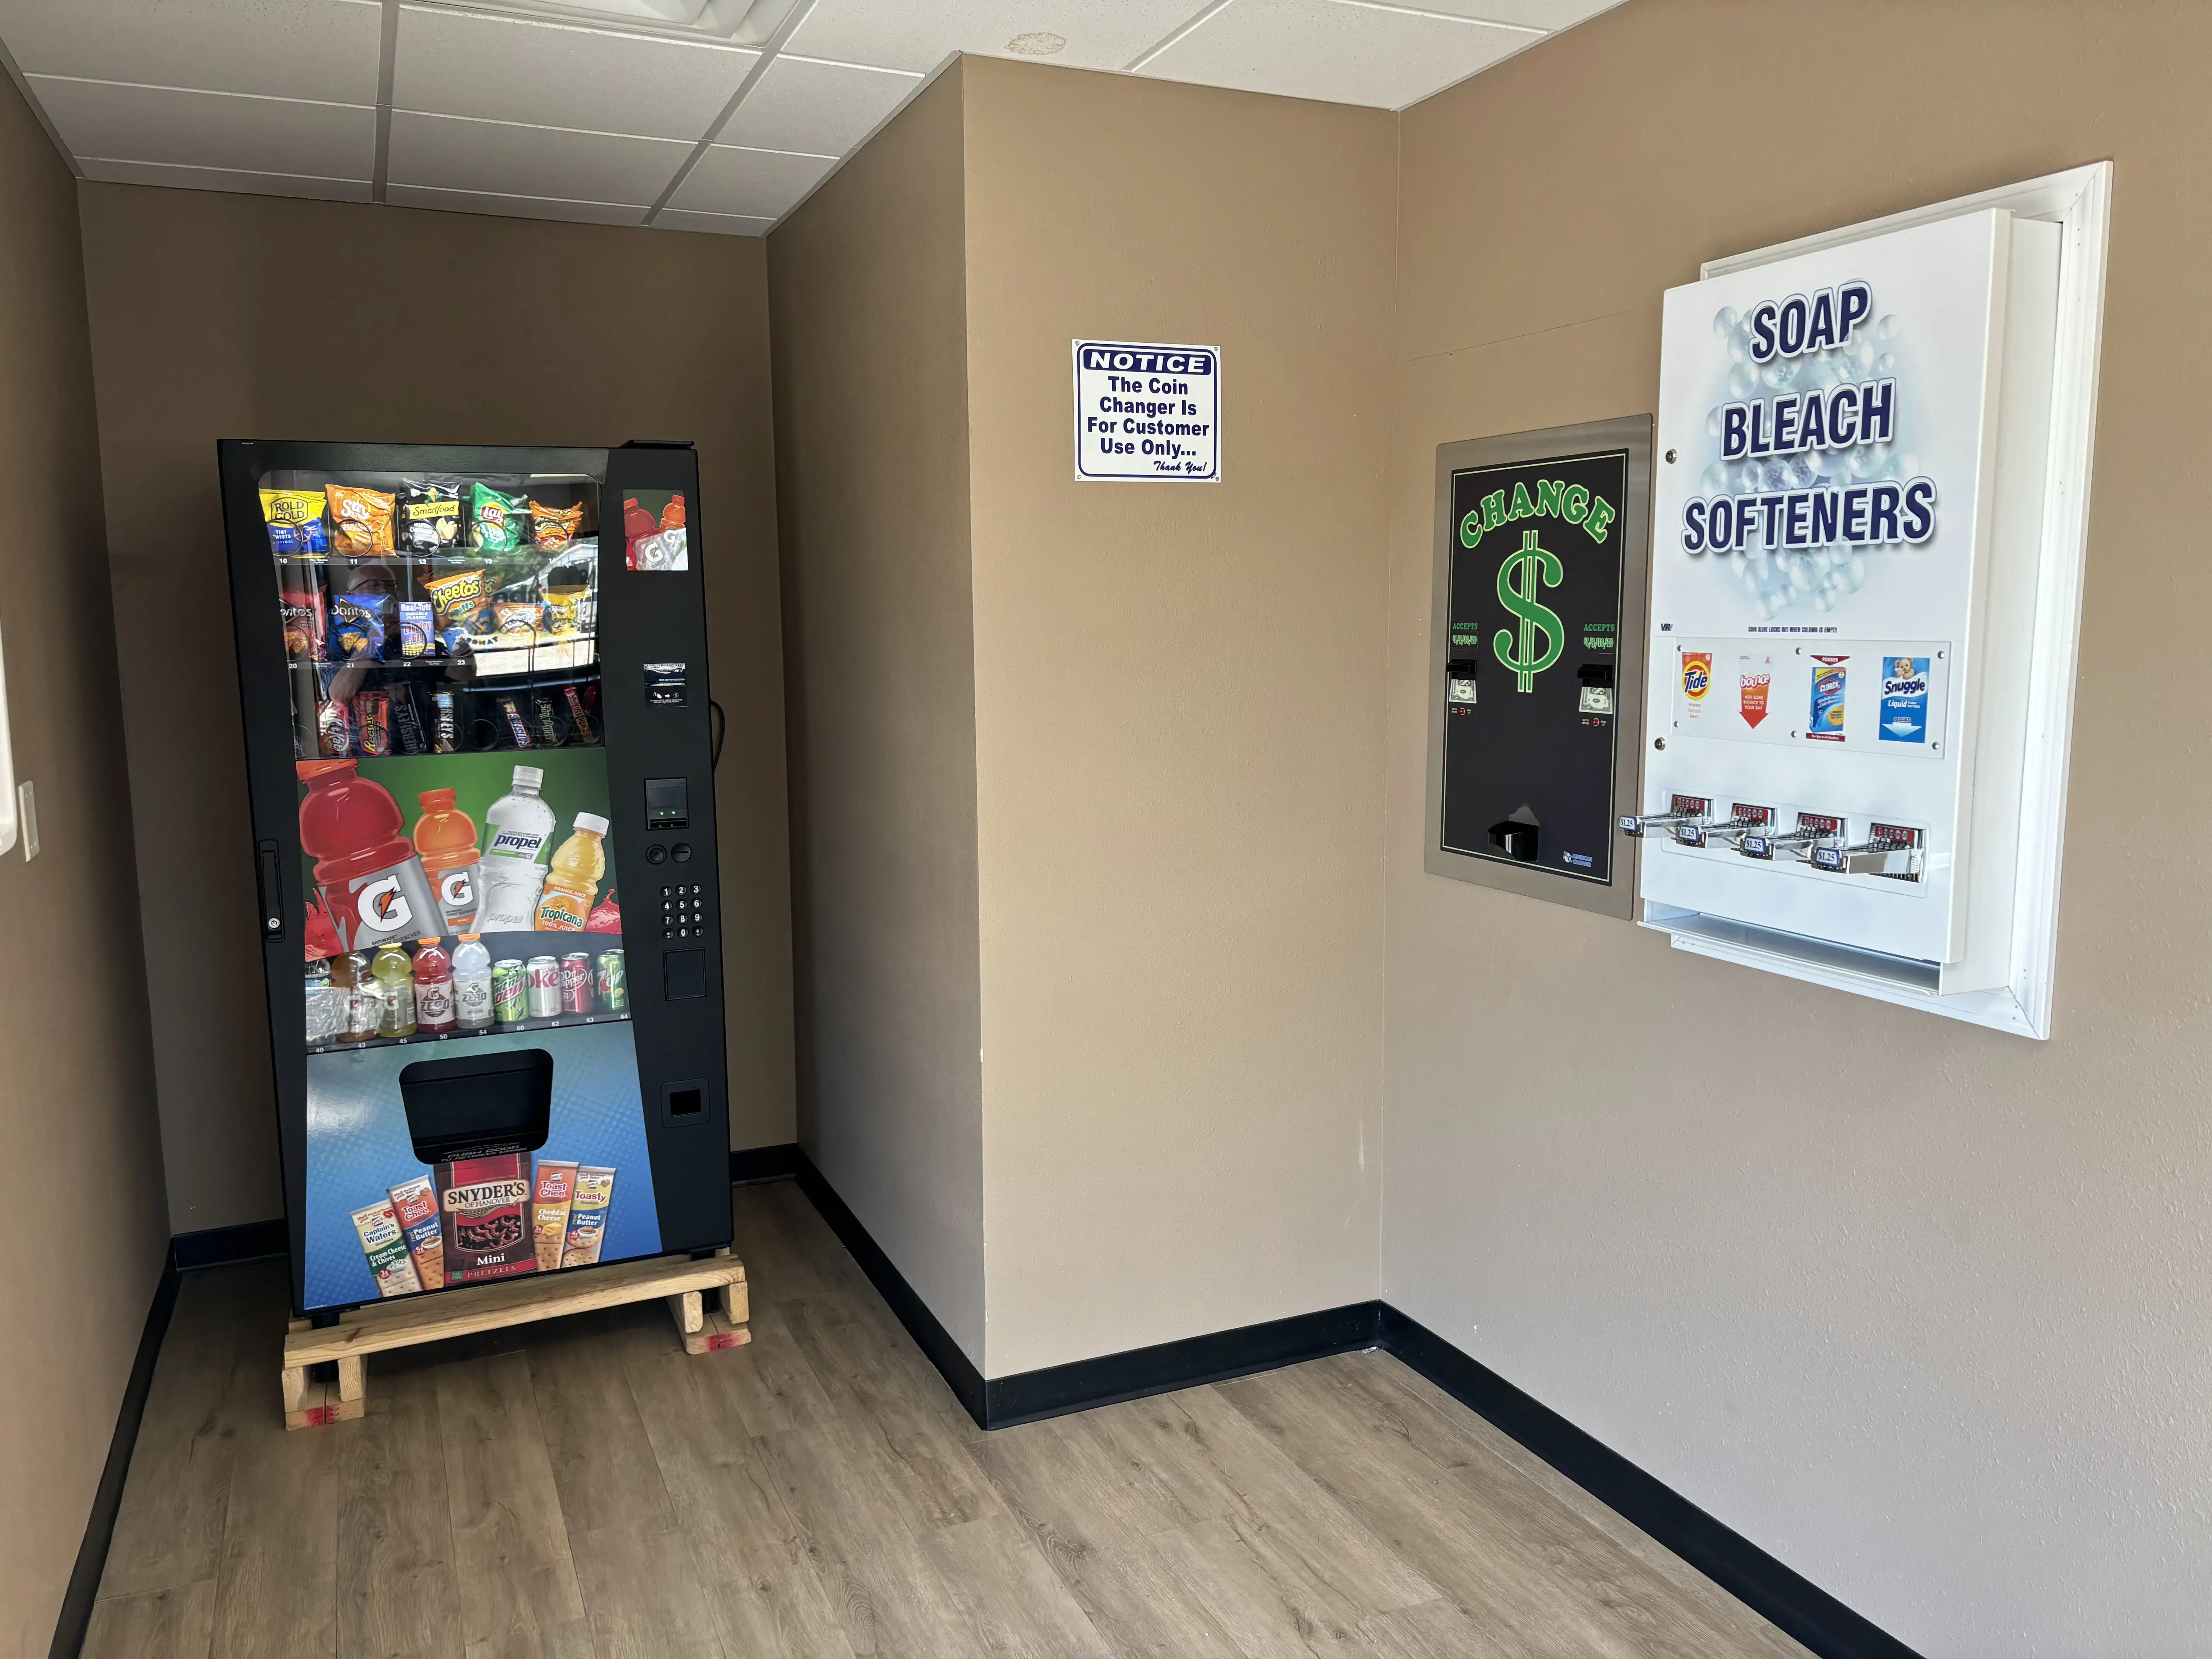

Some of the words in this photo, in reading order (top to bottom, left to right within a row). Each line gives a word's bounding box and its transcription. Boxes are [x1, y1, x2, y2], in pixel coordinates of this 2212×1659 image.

[1750, 283, 1871, 361] SOAP
[1090, 351, 1205, 373] NOTICE
[1108, 376, 1142, 392] The
[1149, 378, 1188, 395] Coin
[1100, 397, 1175, 418] Changer
[1182, 400, 1197, 415] Is
[1722, 380, 1894, 459] BLEACH
[1088, 417, 1117, 433] For
[1123, 418, 1209, 436] Customer
[1101, 438, 1135, 454] Use
[1142, 439, 1196, 459] Only...
[1154, 461, 1181, 471] Thank
[1185, 461, 1207, 474] You!
[275, 501, 304, 512] ROLD
[413, 505, 455, 516] Smartfood
[275, 511, 304, 520] GOLD
[1460, 479, 1615, 549] CHANGE
[1683, 480, 1935, 551] SOFTENERS
[645, 542, 663, 562] G
[433, 580, 479, 613] Cheetos
[331, 605, 372, 618] Doritos
[1684, 671, 1708, 693] Tide
[1741, 675, 1770, 688] bounce
[1884, 678, 1925, 695] Snuggle
[1887, 699, 1907, 708] Liquid
[1681, 828, 1694, 837] $1.25
[494, 835, 542, 849] propel
[1747, 840, 1761, 849] $1.25
[1819, 852, 1835, 862] $1.25
[441, 871, 474, 906] G
[358, 874, 412, 932] G
[541, 907, 582, 927] Tropicana
[372, 935, 397, 945] GATORADE
[393, 930, 421, 943] QUENCHER
[462, 992, 487, 1002] ZERO
[420, 999, 450, 1011] ZERO
[541, 1181, 567, 1190] Toast
[448, 1182, 525, 1205] SNYDER'S
[540, 1189, 565, 1197] Chee
[575, 1191, 606, 1202] Toasty
[402, 1202, 426, 1213] Toast
[476, 1197, 510, 1207] HANOVER
[405, 1209, 428, 1220] Chee
[364, 1223, 395, 1237] Captain's
[413, 1223, 438, 1235] Peanut
[415, 1229, 437, 1241] Butter
[366, 1230, 396, 1243] Wafers
[369, 1252, 387, 1261] Cream
[388, 1245, 407, 1255] Cheese
[378, 1254, 395, 1264] Chives
[477, 1253, 505, 1266] Mini
[468, 1266, 516, 1278] PRETZELS
